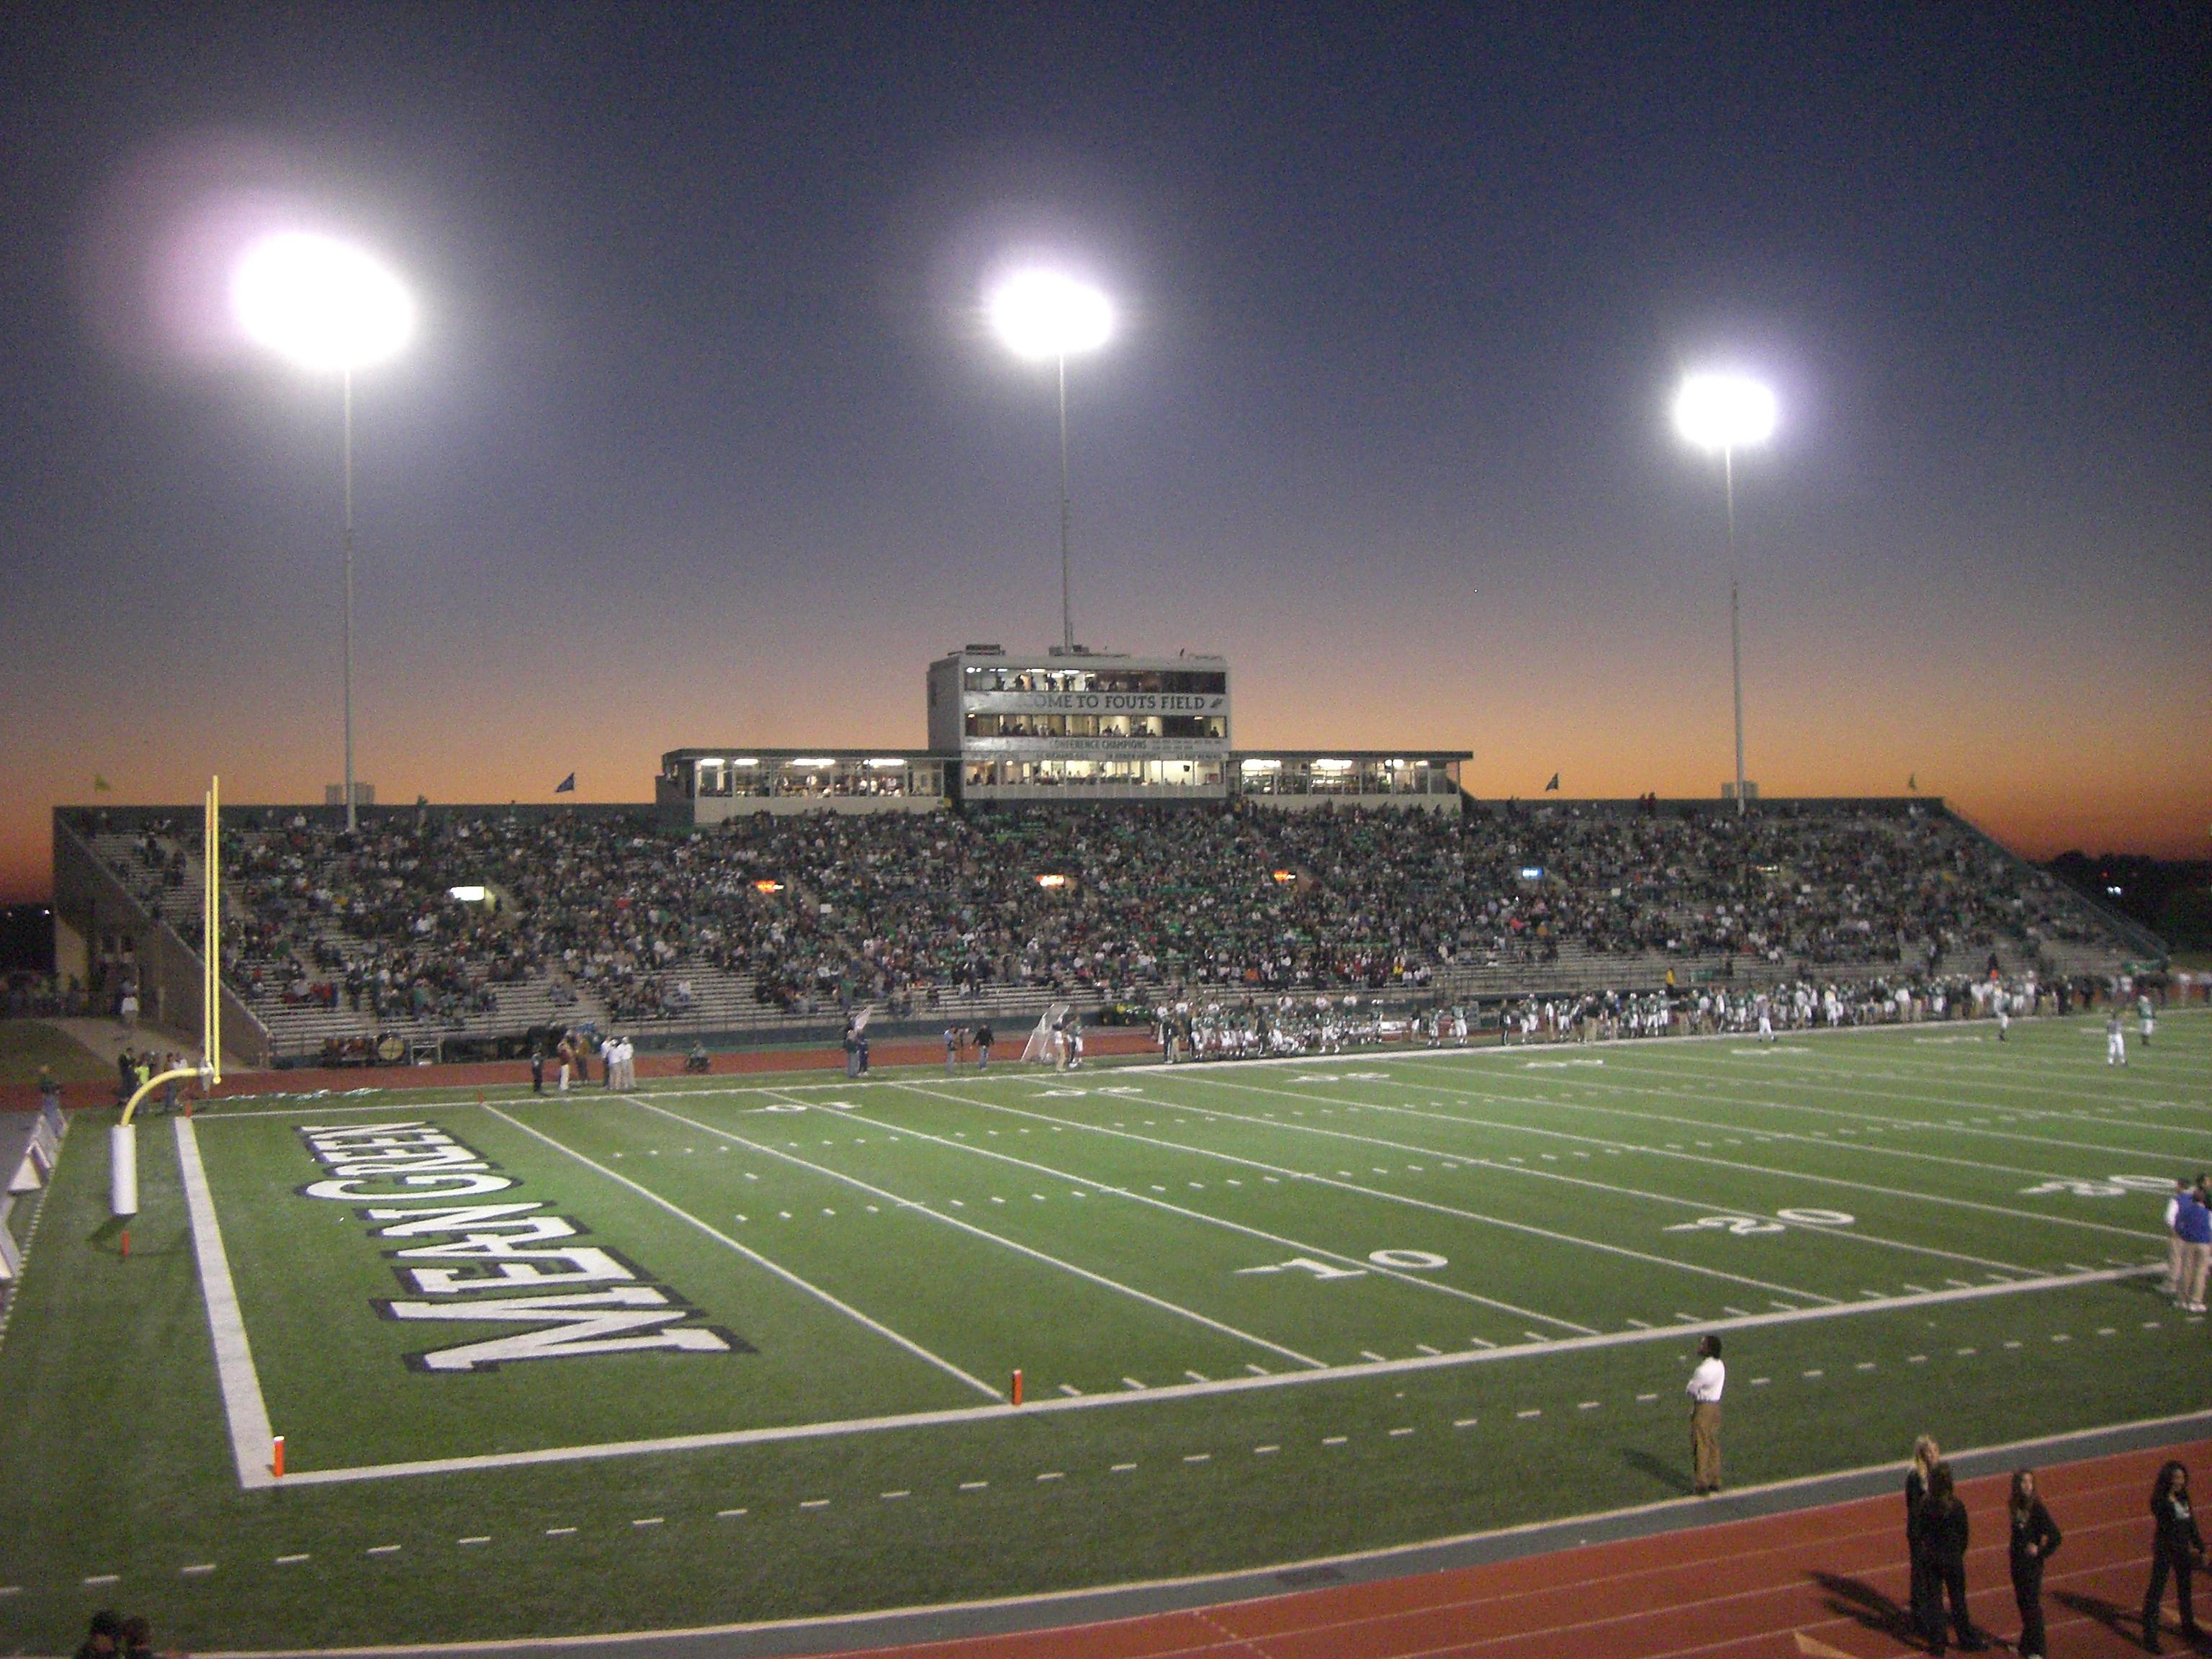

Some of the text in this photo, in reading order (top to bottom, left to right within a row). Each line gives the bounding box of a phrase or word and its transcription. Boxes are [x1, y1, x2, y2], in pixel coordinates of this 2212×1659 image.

[1076, 695, 1099, 708] TO
[1105, 696, 1156, 709] FOUTS
[1161, 696, 1205, 710] FIELD
[1102, 739, 1148, 750] CHAMPIONS
[1696, 1208, 1855, 1236] 20
[295, 1120, 745, 1371] MEAN GREEN
[1279, 1249, 1449, 1280] 10
